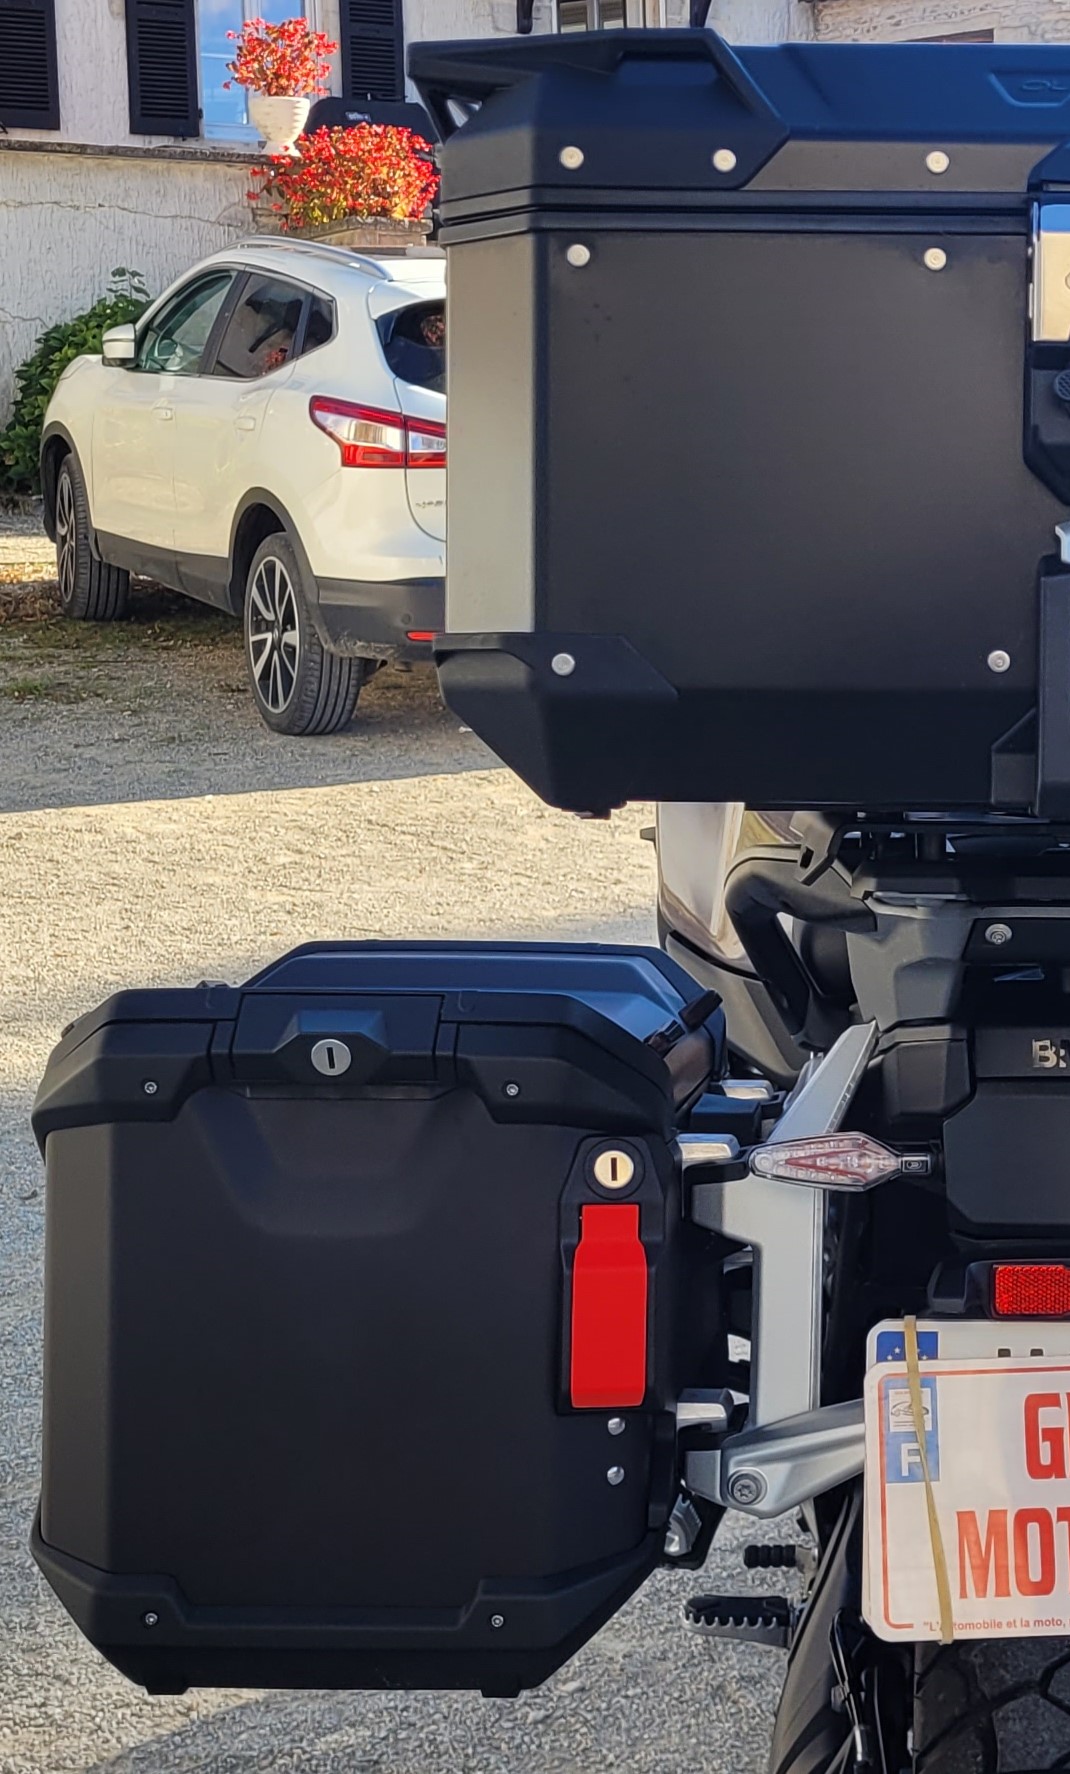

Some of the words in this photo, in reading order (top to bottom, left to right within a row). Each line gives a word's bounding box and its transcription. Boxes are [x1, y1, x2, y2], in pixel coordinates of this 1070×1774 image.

[900, 1442, 922, 1477] F
[1006, 1617, 1017, 1629] et
[1020, 1616, 1030, 1628] la
[1033, 1616, 1066, 1629] moto,
